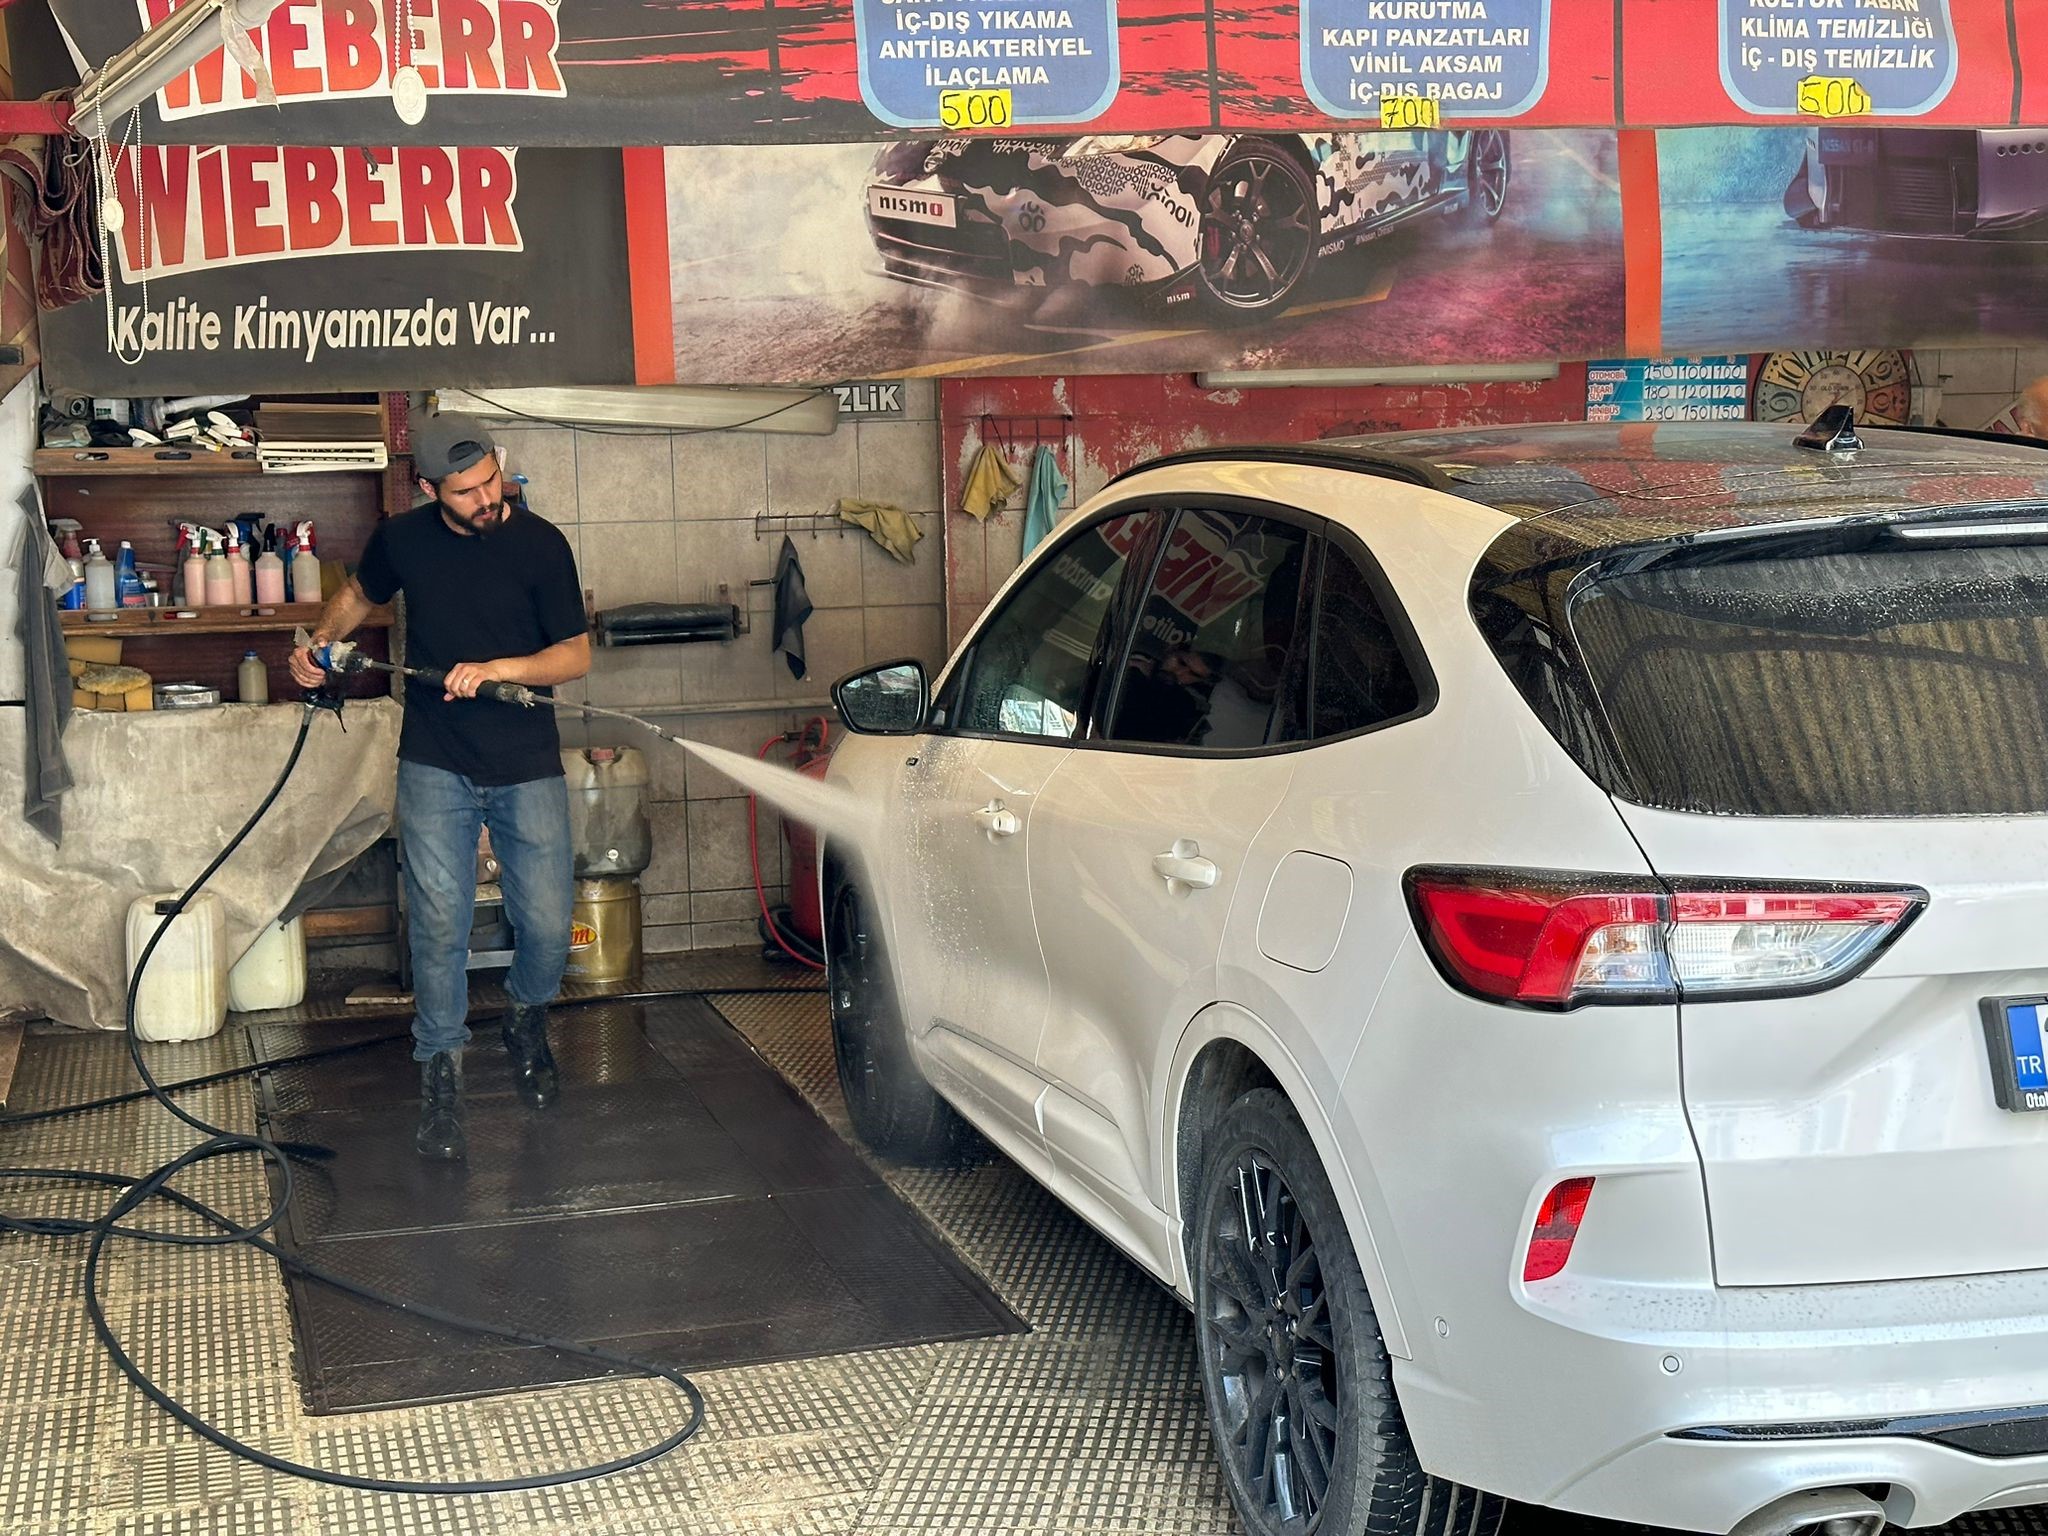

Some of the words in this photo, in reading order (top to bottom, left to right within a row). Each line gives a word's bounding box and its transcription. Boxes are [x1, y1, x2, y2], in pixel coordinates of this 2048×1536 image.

[895, 9, 970, 35] İÇ-DIŞ
[977, 10, 1073, 29] YIKAMA
[1368, 1, 1487, 20] KURUTMA
[1322, 28, 1378, 47] KAPI
[1386, 28, 1529, 46] PANZATLARI
[1740, 14, 1810, 38] KLİMA
[1817, 15, 1934, 39] TEMİZLİĞİ
[879, 35, 1092, 59] ANTİBAKTERİYEL
[1781, 48, 1818, 73] DIŞ
[1824, 44, 1936, 69] TEMİZLİK
[1350, 52, 1413, 73] VİNİL
[1419, 55, 1502, 73] AKSAM
[925, 63, 1050, 89] İLAÇLAMA
[1426, 82, 1502, 100] BAGAJ
[1799, 81, 1865, 114] 500
[941, 93, 1007, 126] 500
[1382, 97, 1436, 128] 700
[117, 298, 222, 351] Kalite
[234, 295, 458, 362] Kimyamızda
[1644, 365, 1674, 380] 150
[1682, 366, 1709, 380] 100
[1716, 365, 1742, 380] 100
[1645, 385, 1670, 399] 180
[1682, 385, 1709, 400] 120
[1716, 385, 1746, 400] 120
[1645, 406, 1675, 420] 230
[1682, 405, 1709, 421] 150
[1716, 406, 1741, 420] 150
[2016, 1055, 2043, 1075] TR
